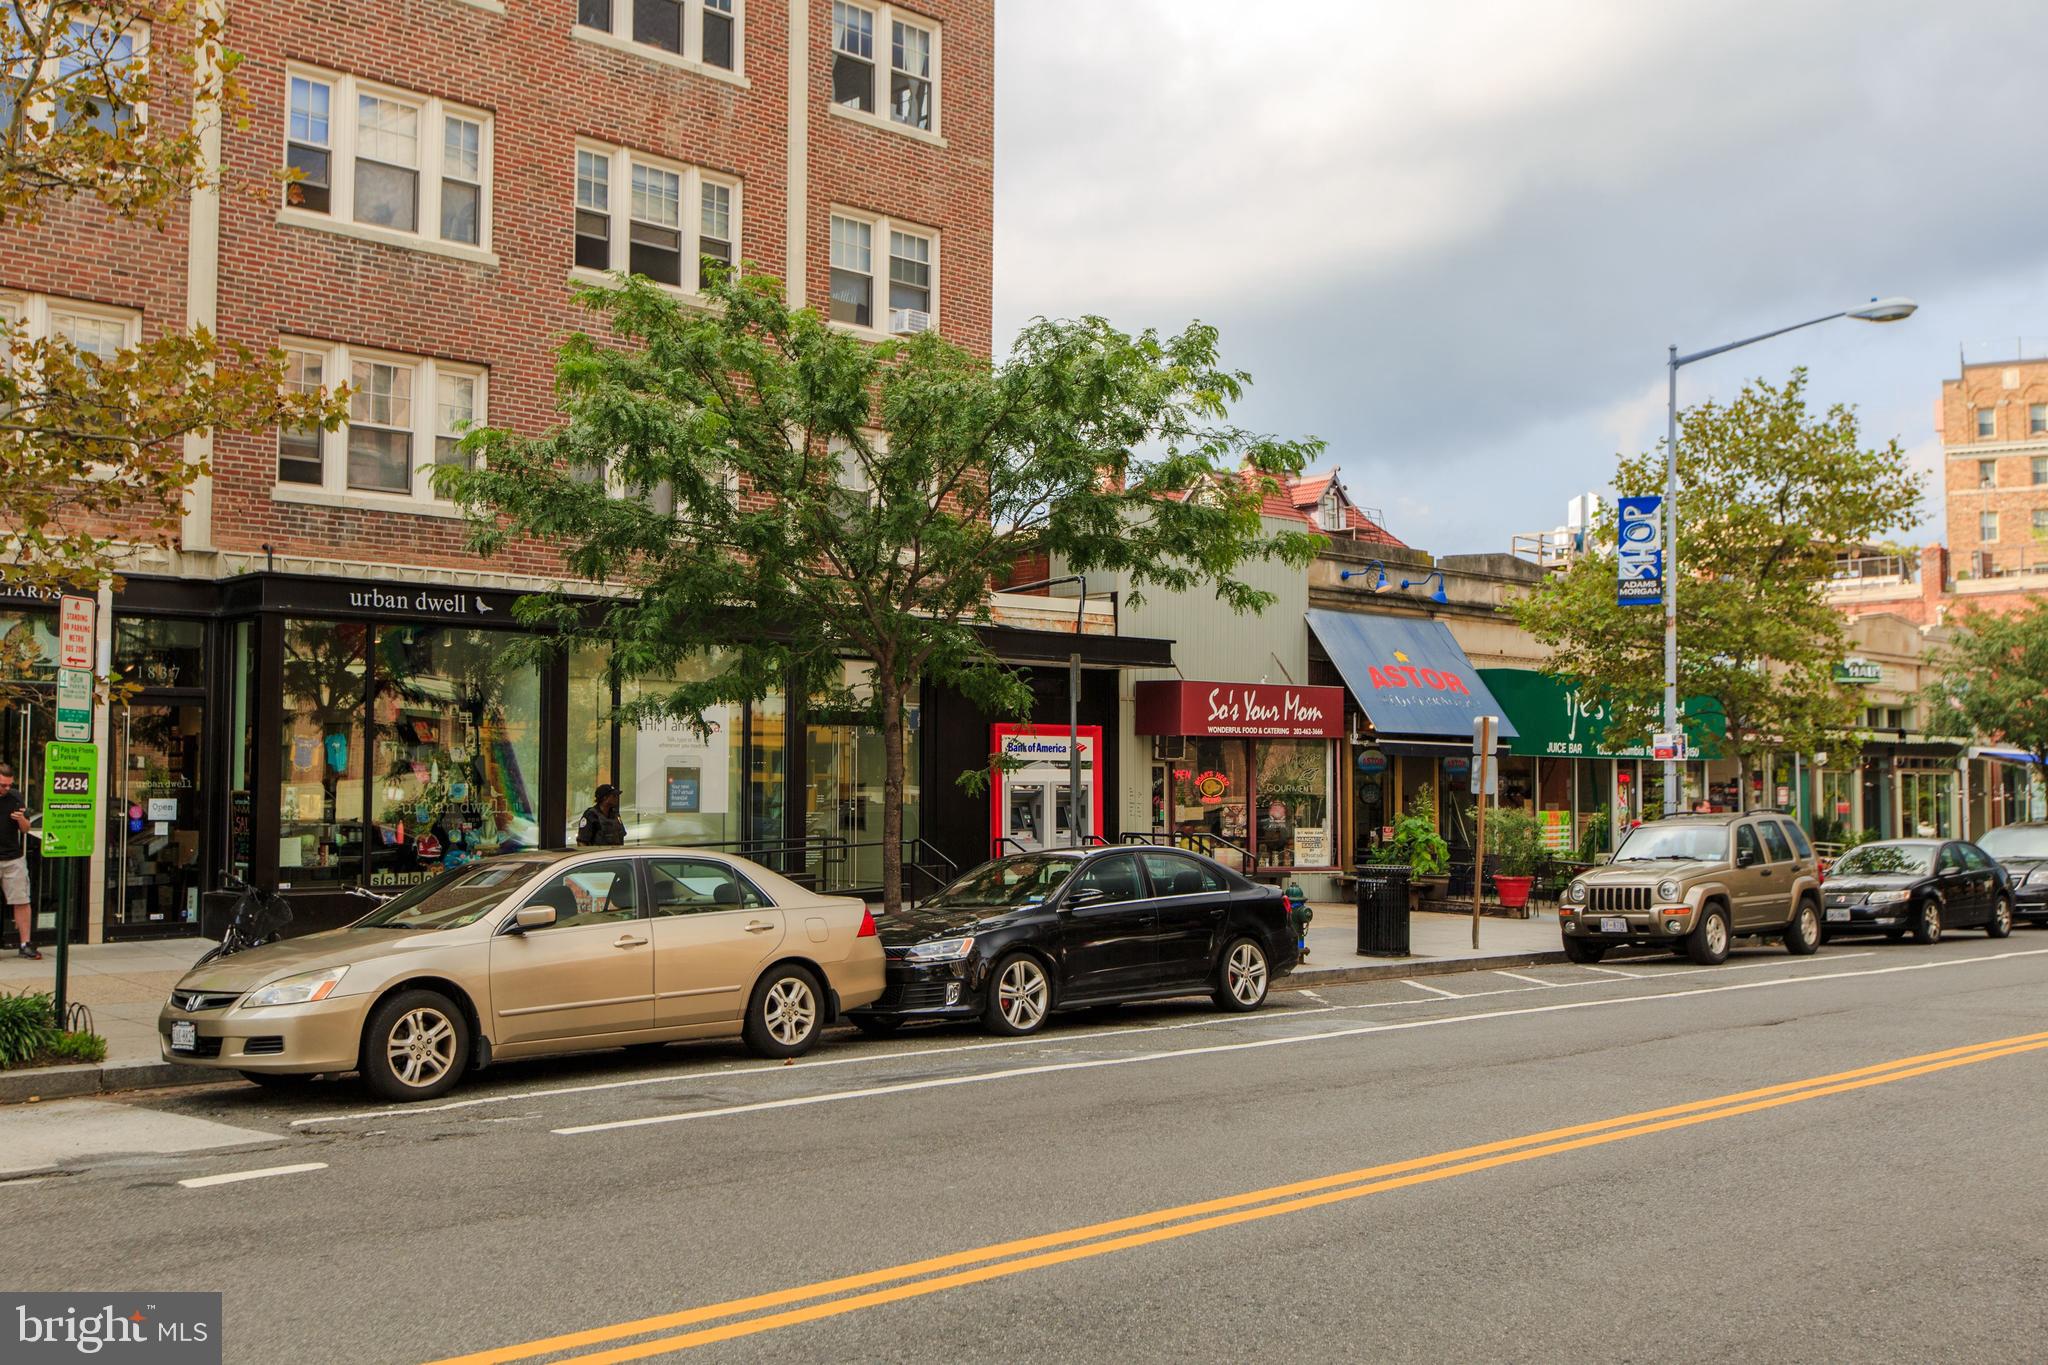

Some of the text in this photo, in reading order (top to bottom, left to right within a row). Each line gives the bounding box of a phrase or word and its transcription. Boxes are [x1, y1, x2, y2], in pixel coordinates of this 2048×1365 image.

[1622, 506, 1658, 577] SHOP
[1623, 580, 1657, 588] ADAMS
[0, 585, 62, 599] IARDS
[1620, 588, 1661, 596] MORGAN
[350, 588, 466, 613] urban dwell
[67, 613, 88, 622] STANDING
[71, 624, 92, 633] PARKING
[69, 634, 84, 642] METRO
[76, 646, 87, 654] ZONE
[138, 666, 180, 679] 1837
[1368, 665, 1470, 695] ASTOR
[1208, 688, 1323, 721] So's Your Mom
[1207, 726, 1241, 734] WONDERFUL
[1263, 727, 1290, 735] CATERING
[1008, 743, 1067, 753] Bank of America
[1547, 742, 1582, 754] JUICE BAR
[54, 777, 88, 791] 22434
[167, 780, 192, 788] dwell
[152, 803, 173, 812] Open
